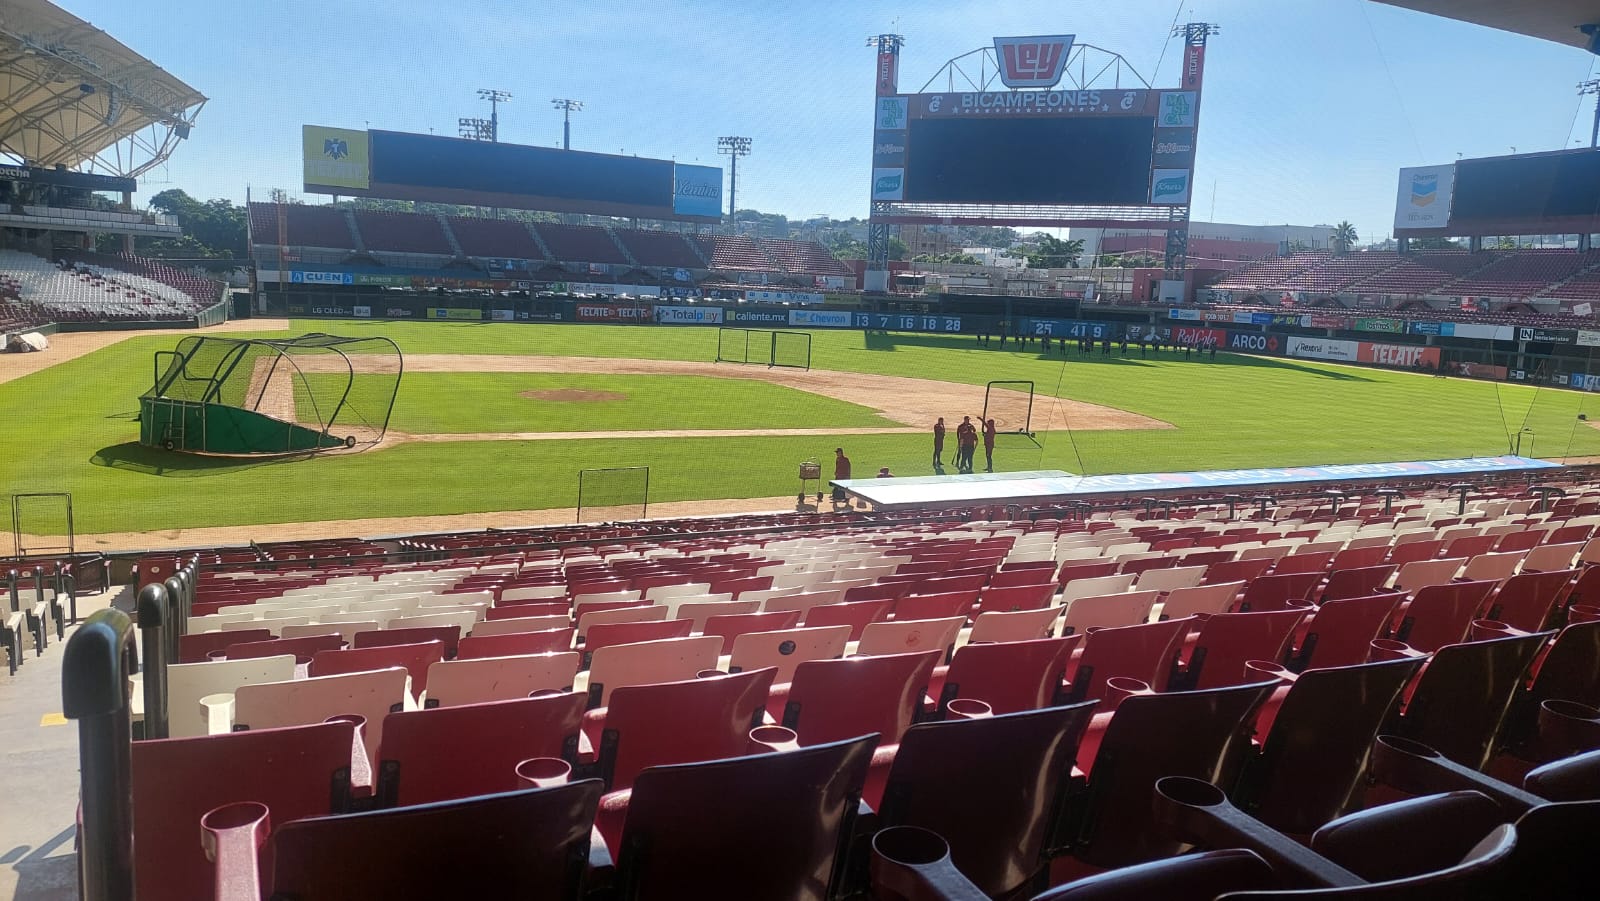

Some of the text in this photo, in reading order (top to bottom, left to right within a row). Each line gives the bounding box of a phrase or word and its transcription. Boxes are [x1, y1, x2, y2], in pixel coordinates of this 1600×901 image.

[961, 91, 1101, 108] BICAMPEONES
[578, 307, 608, 317] TECATE
[616, 307, 649, 318] TECATE
[672, 310, 718, 323] Totalplay
[735, 312, 785, 322] caliente.mx
[809, 313, 846, 324] Chevron
[856, 316, 869, 327] 13
[880, 317, 888, 327] 7
[900, 318, 914, 329] 16
[922, 319, 936, 330] 18
[945, 320, 960, 331] 28
[1071, 325, 1086, 337] 41
[1093, 326, 1102, 337] 9
[1232, 334, 1267, 350] ARCO
[1300, 342, 1323, 353] Rexona
[1370, 344, 1424, 367] TECATE
